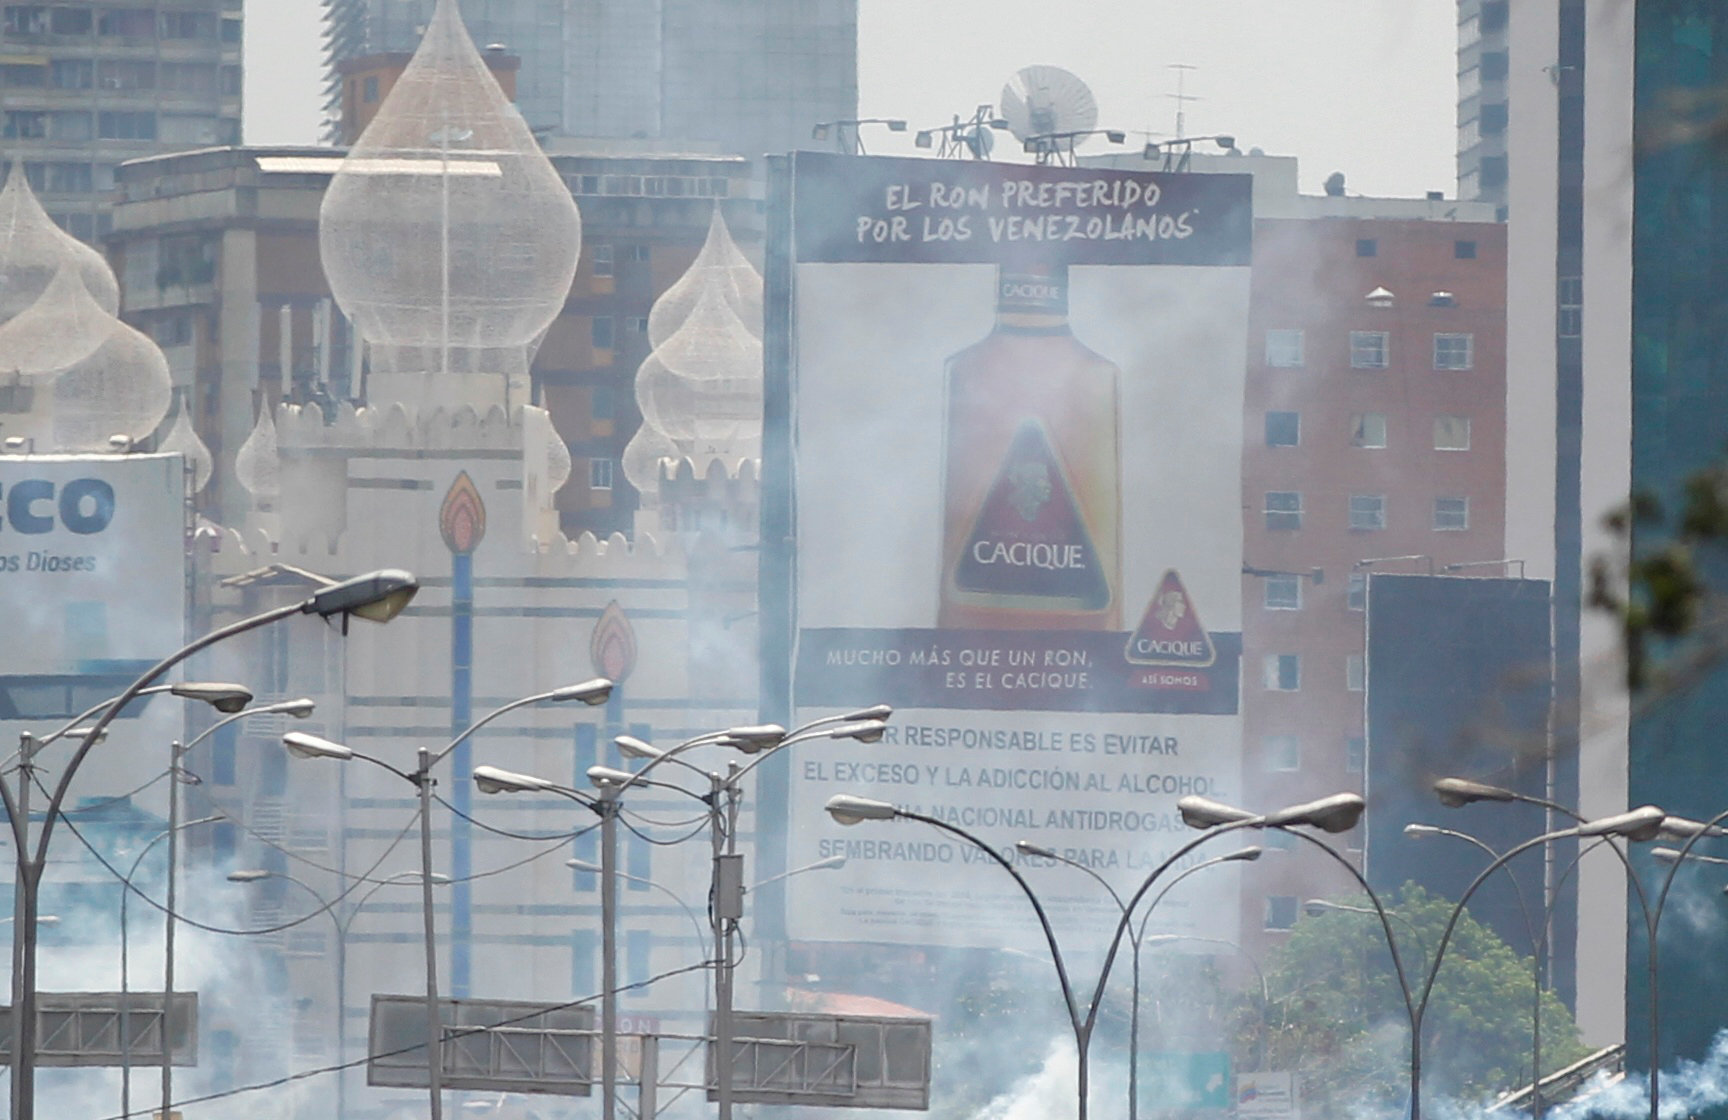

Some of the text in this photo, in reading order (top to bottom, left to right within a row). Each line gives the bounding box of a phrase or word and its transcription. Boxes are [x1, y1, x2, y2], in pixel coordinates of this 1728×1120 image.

[887, 180, 1160, 210] EL RON PREFERIDO
[857, 212, 1194, 242] POR LOS VENEZOLANOS
[1003, 283, 1059, 299] CACIQUE
[0, 478, 115, 535] CO
[27, 551, 96, 572] Dioses
[974, 541, 1081, 569] CACIQUE
[827, 645, 1093, 669] MUCHO MÁS QUE UN RON,
[1137, 639, 1203, 657] CACIQUE
[946, 671, 1093, 691] ES EL CACIQUE.
[905, 726, 1062, 752] RESPONSABLE
[1070, 733, 1096, 754] ES
[1105, 734, 1178, 756] EVITAR
[804, 761, 1227, 798] EL EXCESO Y LA ADICCIÓN AL ALCOHOL.
[932, 805, 1040, 829] NACIONAL
[819, 840, 953, 864] SEMBRANDO
[1064, 848, 1118, 870] PARA
